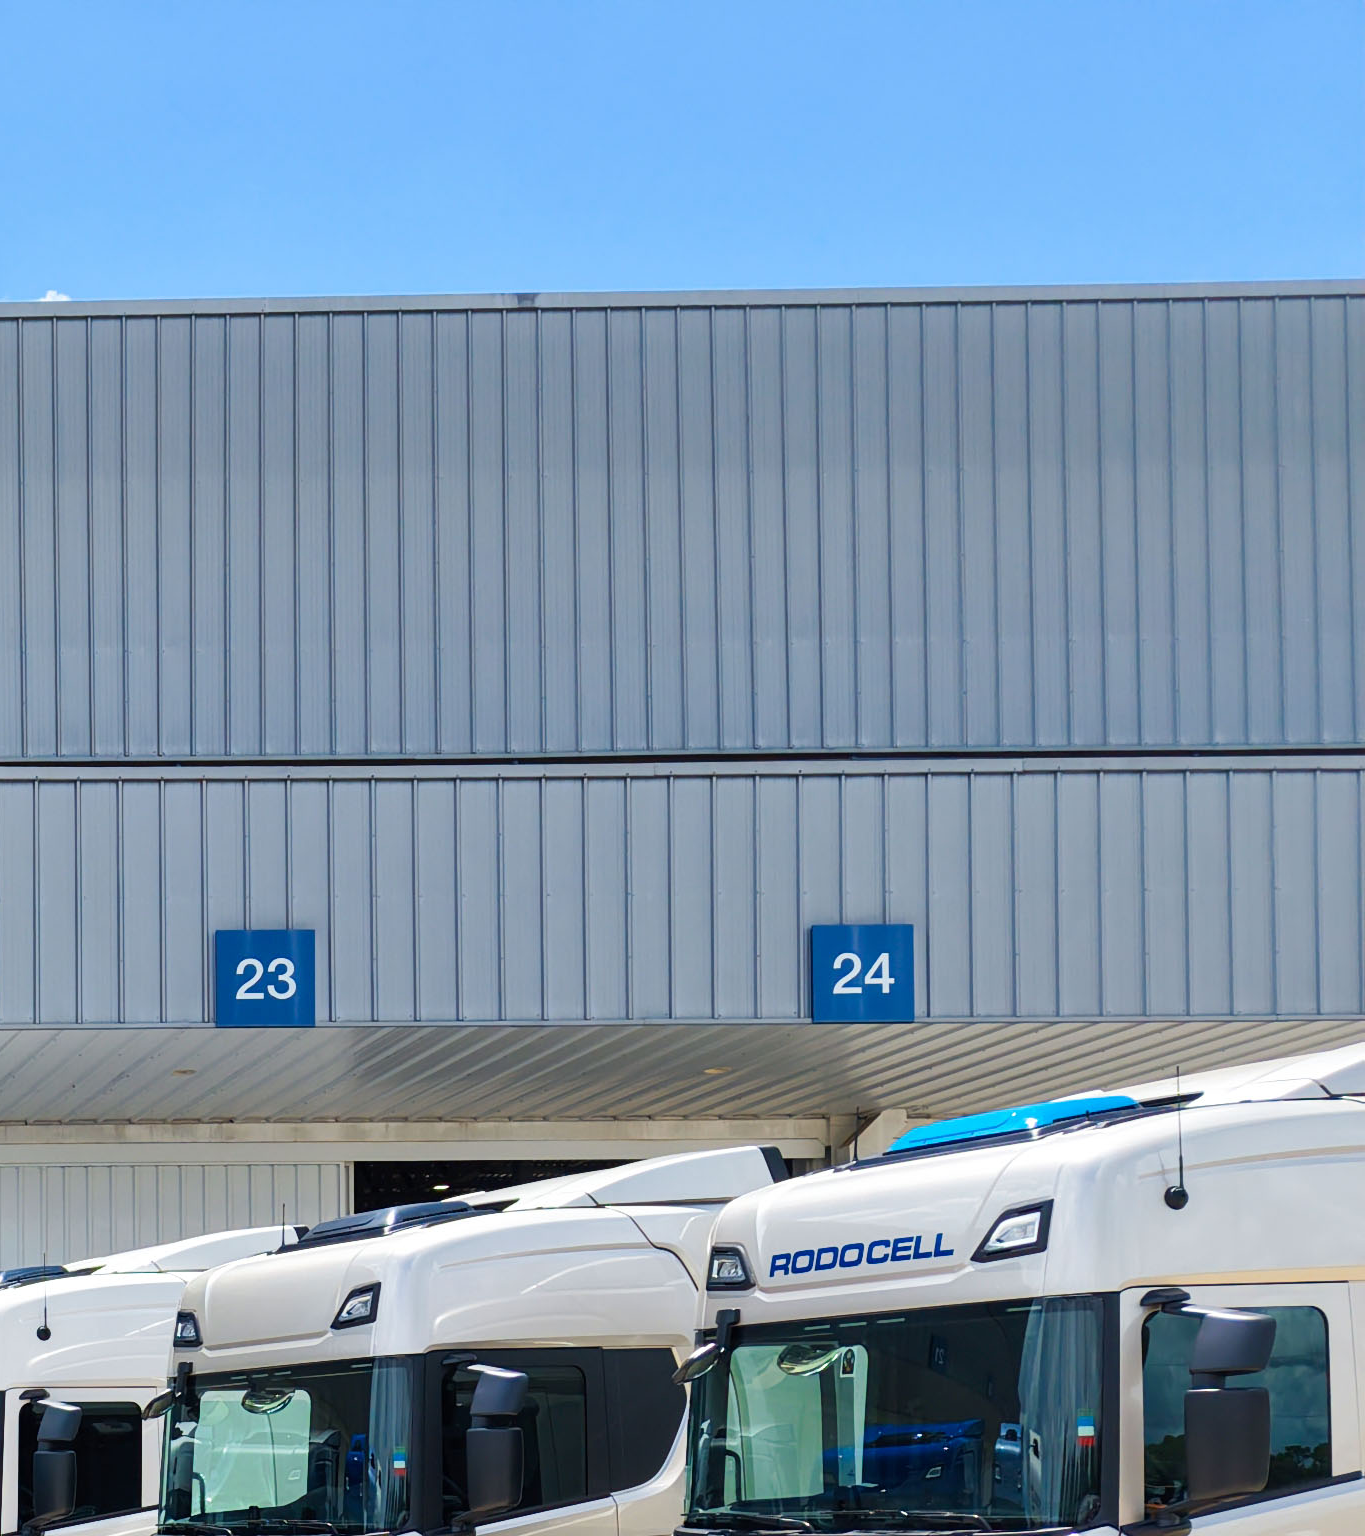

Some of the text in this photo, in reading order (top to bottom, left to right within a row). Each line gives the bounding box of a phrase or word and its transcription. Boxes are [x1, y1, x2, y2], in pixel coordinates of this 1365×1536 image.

[235, 957, 297, 1000] 23
[832, 952, 895, 994] 24
[769, 1233, 955, 1278] RODOCELL
